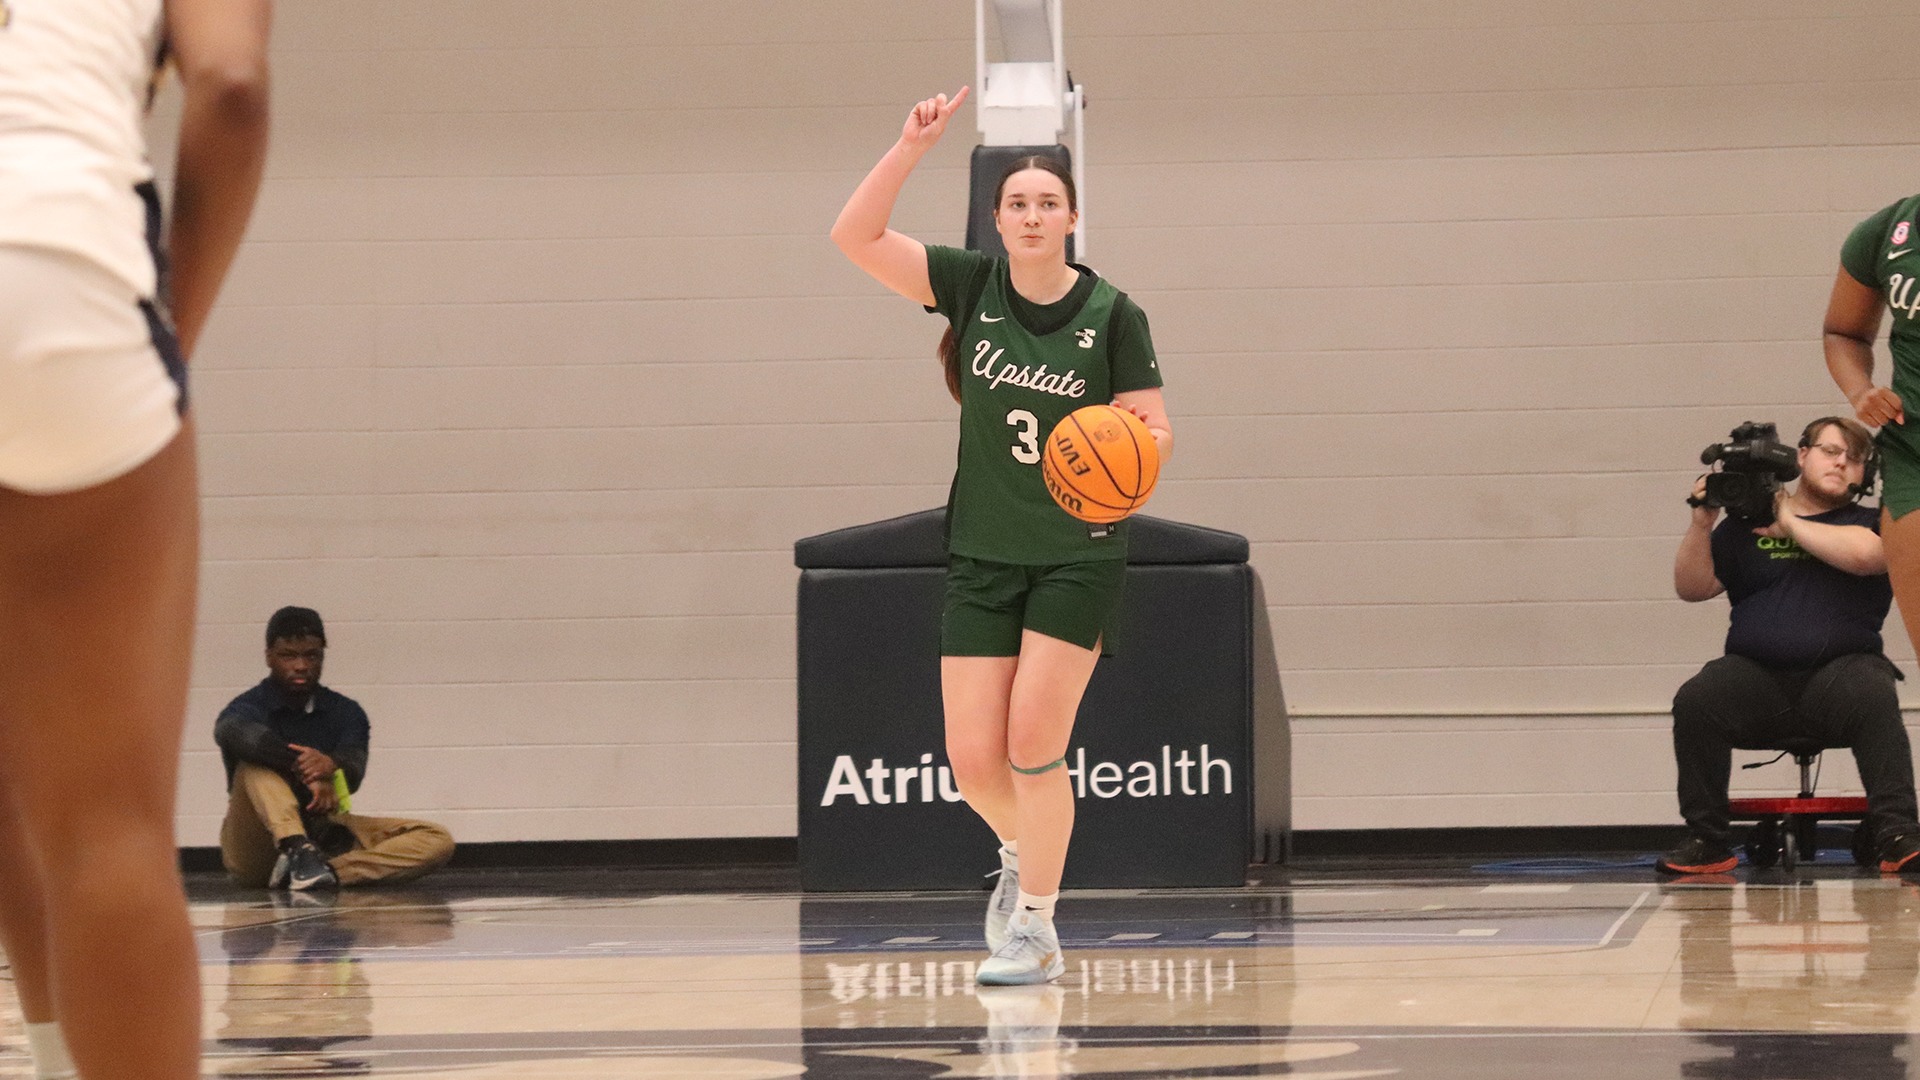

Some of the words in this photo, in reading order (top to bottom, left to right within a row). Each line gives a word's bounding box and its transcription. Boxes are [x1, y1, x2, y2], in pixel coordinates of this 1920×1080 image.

[971, 339, 1086, 398] Upstate
[1006, 408, 1041, 465] 3
[820, 753, 966, 807] Atriu
[1067, 744, 1232, 798] Health
